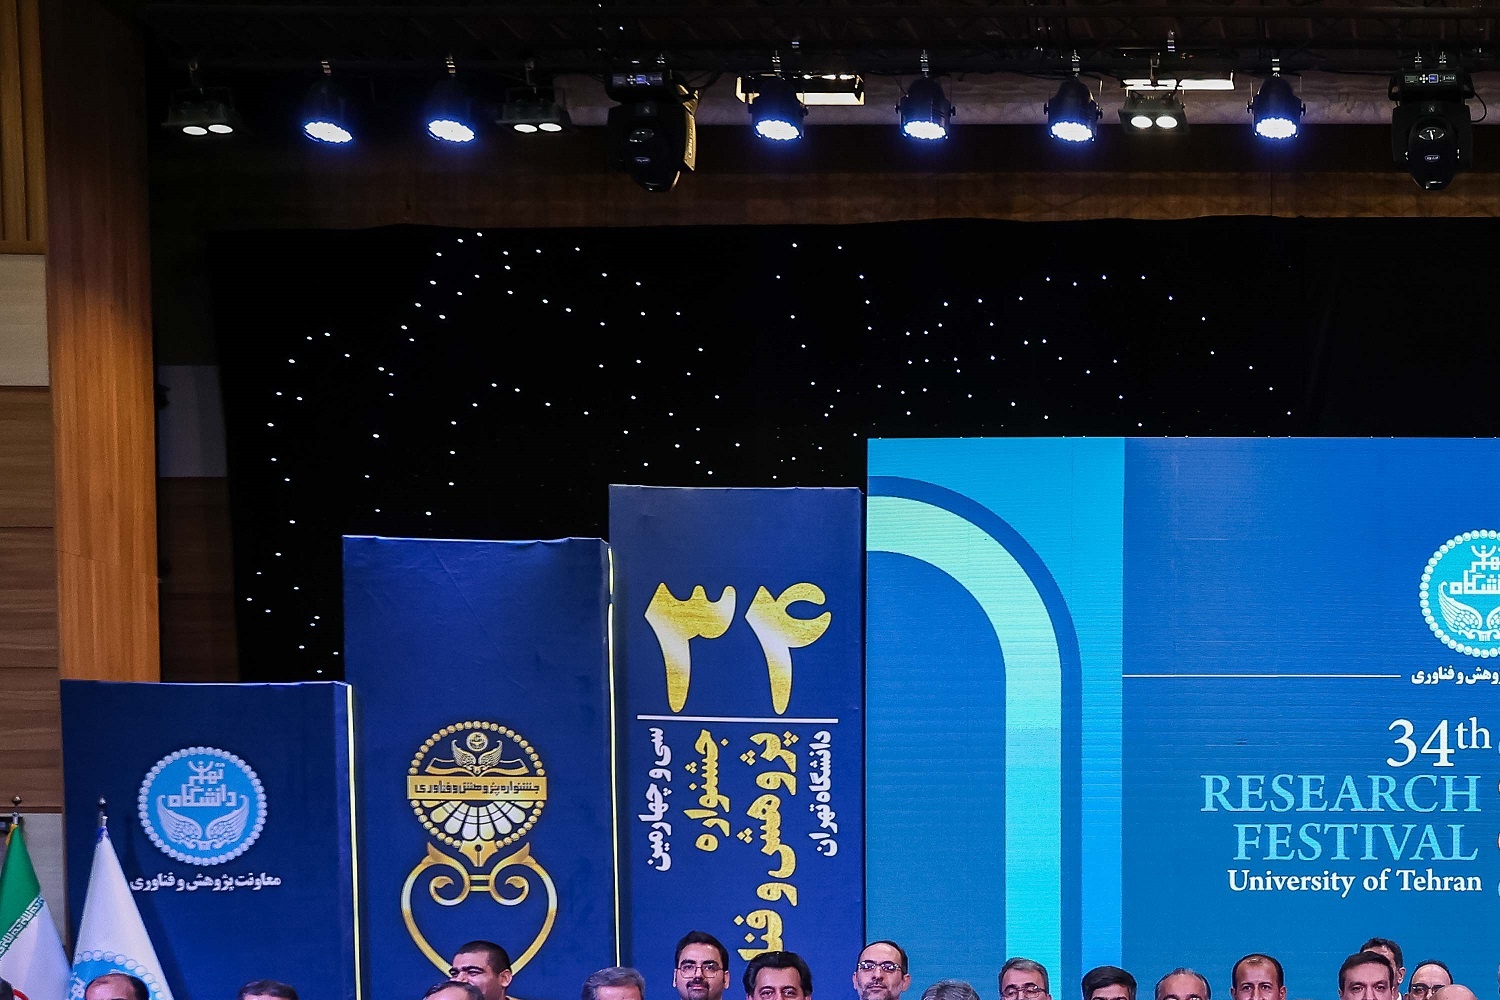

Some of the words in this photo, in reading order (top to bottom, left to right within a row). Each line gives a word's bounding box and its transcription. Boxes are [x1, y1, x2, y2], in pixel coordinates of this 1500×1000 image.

[644, 582, 832, 715] ۳۴
[1411, 665, 1455, 685] فناوری
[1455, 672, 1464, 685] و
[648, 727, 672, 767] سی
[1386, 716, 1493, 768] 34th
[648, 768, 672, 782] و
[808, 730, 832, 803] دانشگاه
[168, 784, 237, 807] دانشگاه
[415, 780, 453, 794] فناوری
[460, 781, 500, 796] پژوهش
[501, 780, 540, 794] جشنواره
[683, 729, 731, 852] جشنواره
[1200, 774, 1482, 812] RESEARCH
[736, 730, 799, 879] پژوهش
[637, 783, 673, 872] چهارمین
[808, 804, 838, 857] تهران
[1232, 822, 1479, 861] FESTIVAL
[130, 871, 176, 891] فناوری
[176, 878, 186, 891] و
[186, 872, 235, 892] پژوهش
[234, 872, 282, 891] معاونت
[756, 882, 798, 907] و
[1227, 868, 1356, 898] University
[1362, 867, 1392, 892] of
[1395, 868, 1483, 892] Tehran
[733, 909, 784, 962] فنا
